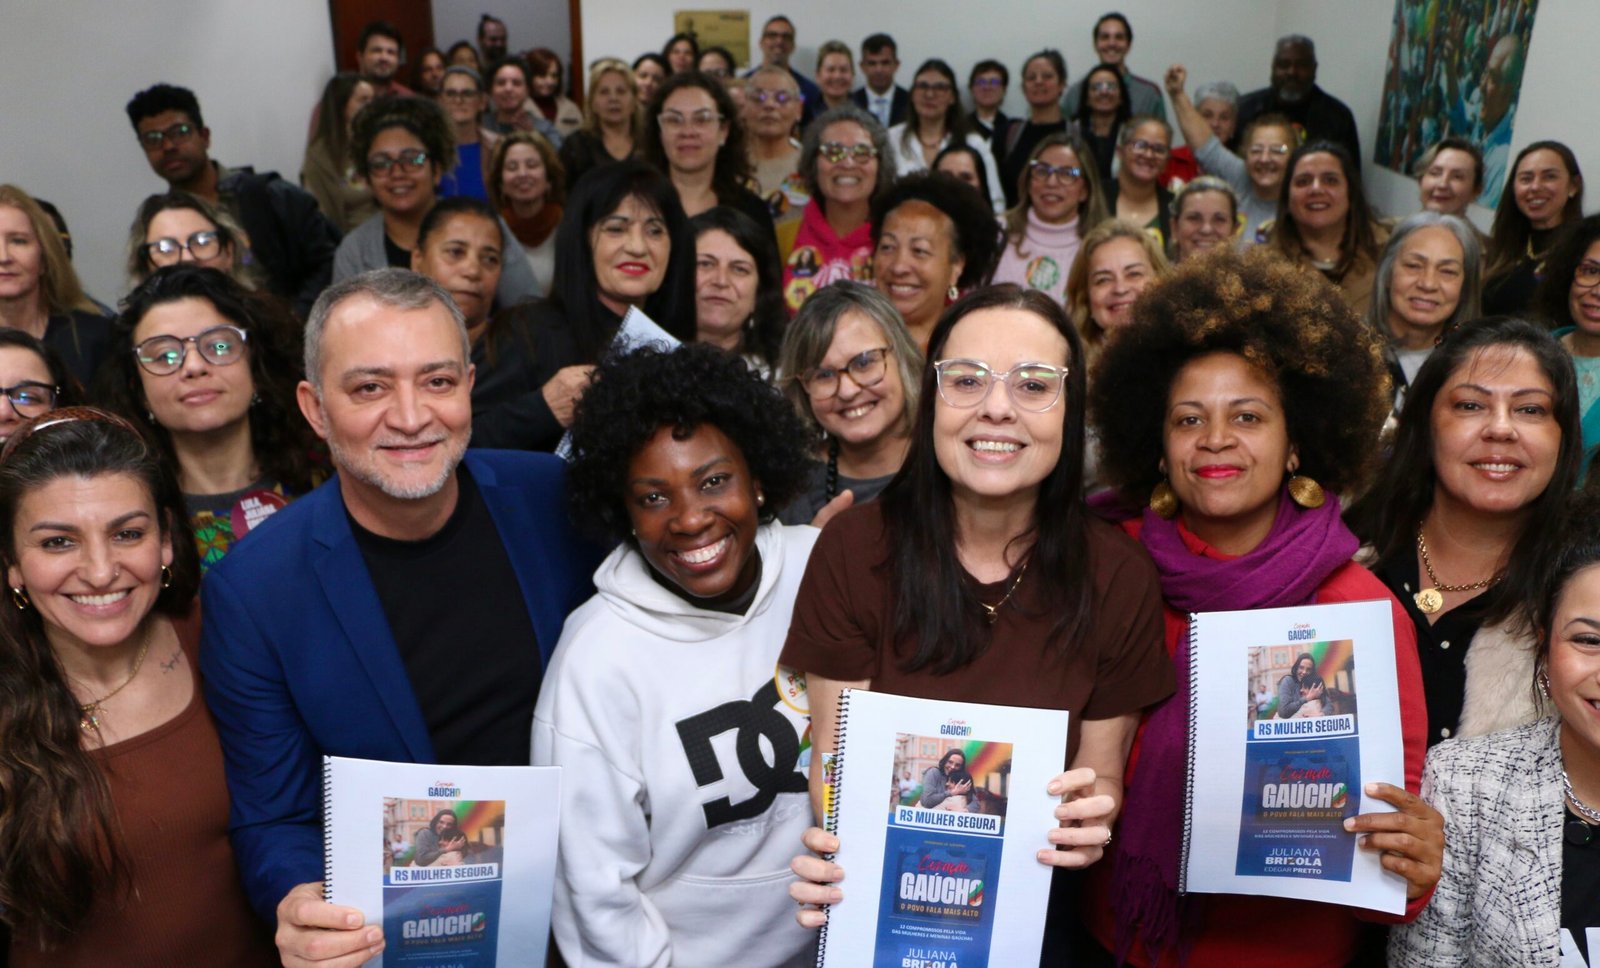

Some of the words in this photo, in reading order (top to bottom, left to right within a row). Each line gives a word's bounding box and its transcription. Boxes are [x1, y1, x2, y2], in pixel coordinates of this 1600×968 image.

[1258, 723, 1271, 735] RS
[1274, 721, 1313, 735] MULHER
[1315, 718, 1351, 732] SEGURA
[1262, 780, 1347, 809] GAÚCHO
[900, 809, 913, 822] RS
[915, 811, 955, 827] MULHER
[957, 815, 996, 831] SEGURA
[1269, 848, 1321, 857] JULIANA
[1265, 856, 1322, 867] BRIZOLA
[395, 870, 409, 881] RS
[411, 868, 452, 881] MULHER
[454, 865, 494, 878] SEGURA
[1292, 867, 1322, 875] PRETTO
[900, 872, 984, 907] GAÚCHO
[907, 903, 924, 912] POVO
[926, 905, 942, 914] FALA
[943, 907, 961, 916] MAIS
[962, 909, 979, 917] ALTO
[906, 947, 957, 961] JULIANA
[902, 958, 958, 968] BRIZOLA
